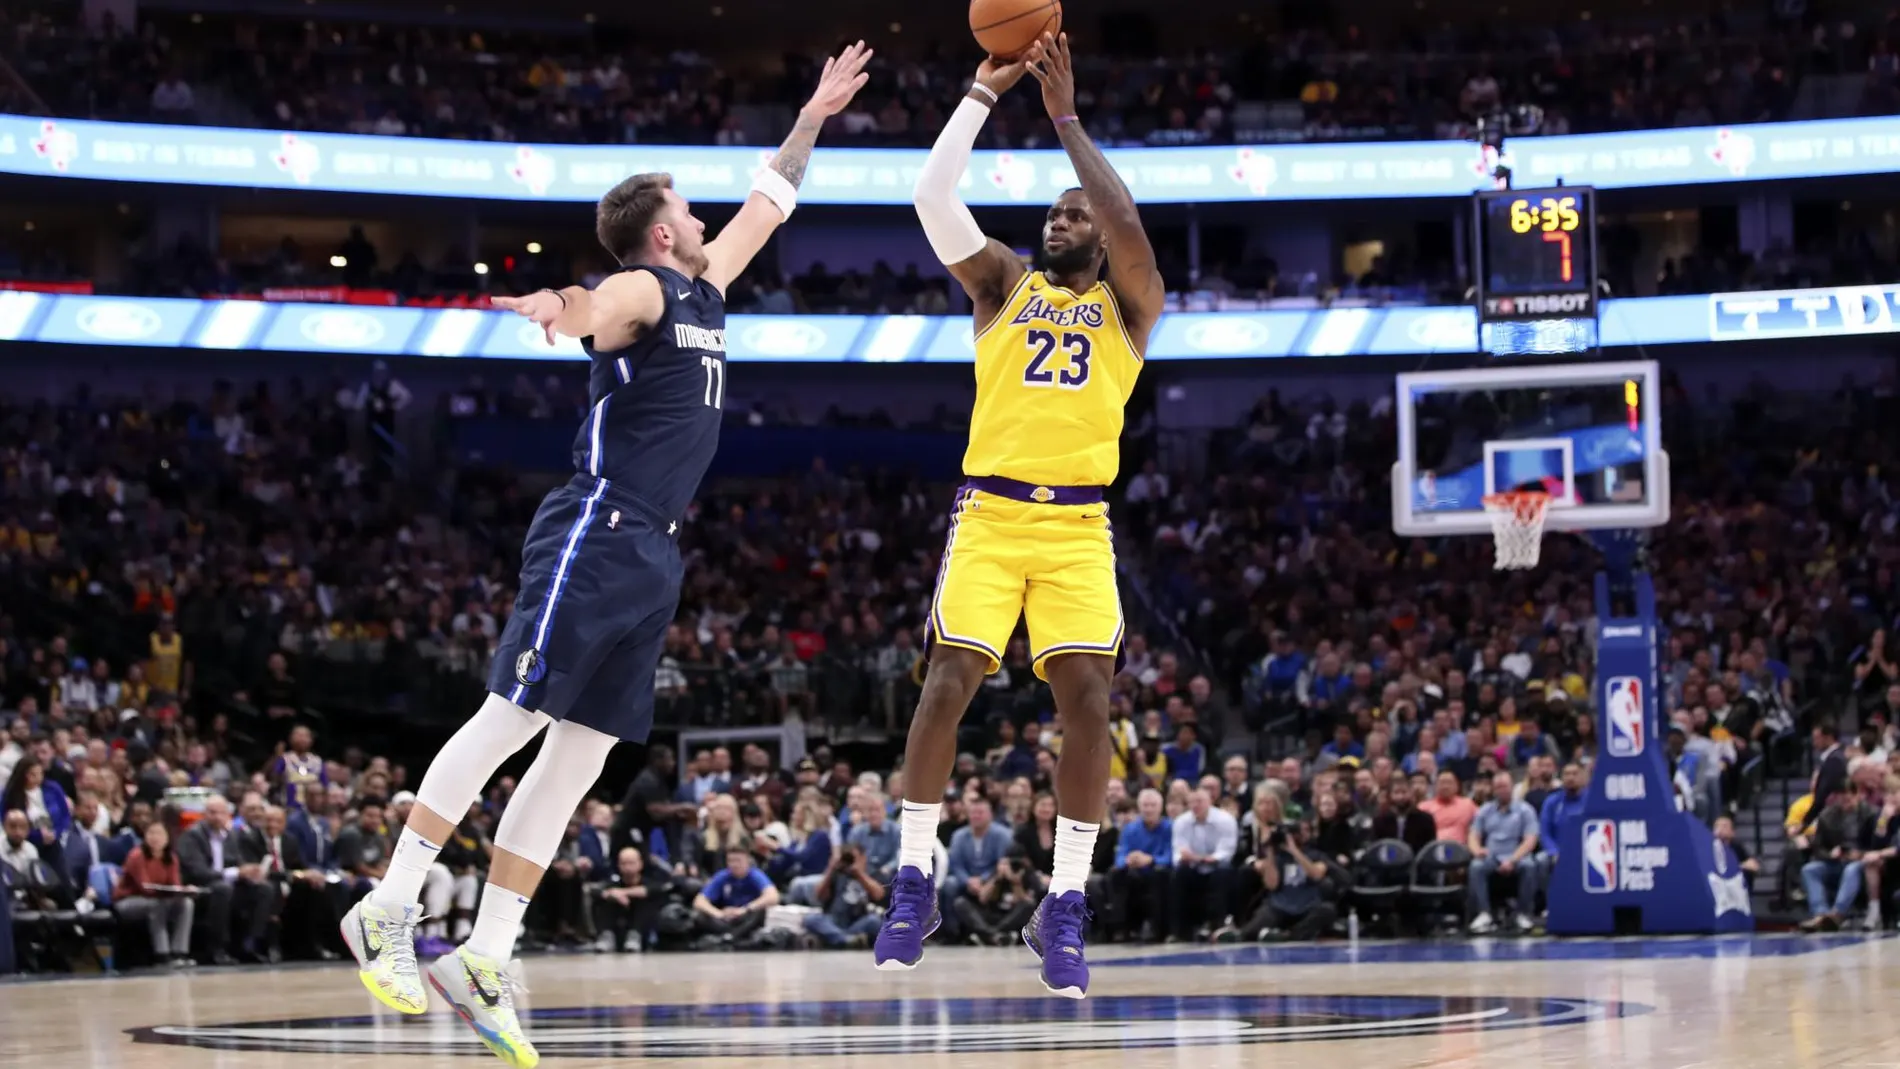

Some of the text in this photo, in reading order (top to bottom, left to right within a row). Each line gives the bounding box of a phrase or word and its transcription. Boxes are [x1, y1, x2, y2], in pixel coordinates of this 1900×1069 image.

[1511, 197, 1579, 233] 6:35
[1542, 230, 1573, 282] 7
[1008, 294, 1104, 329] LAKERS
[1514, 293, 1590, 315] TISSOT
[674, 323, 727, 352] MAVERICK
[1023, 328, 1091, 391] 23
[701, 355, 723, 410] 77
